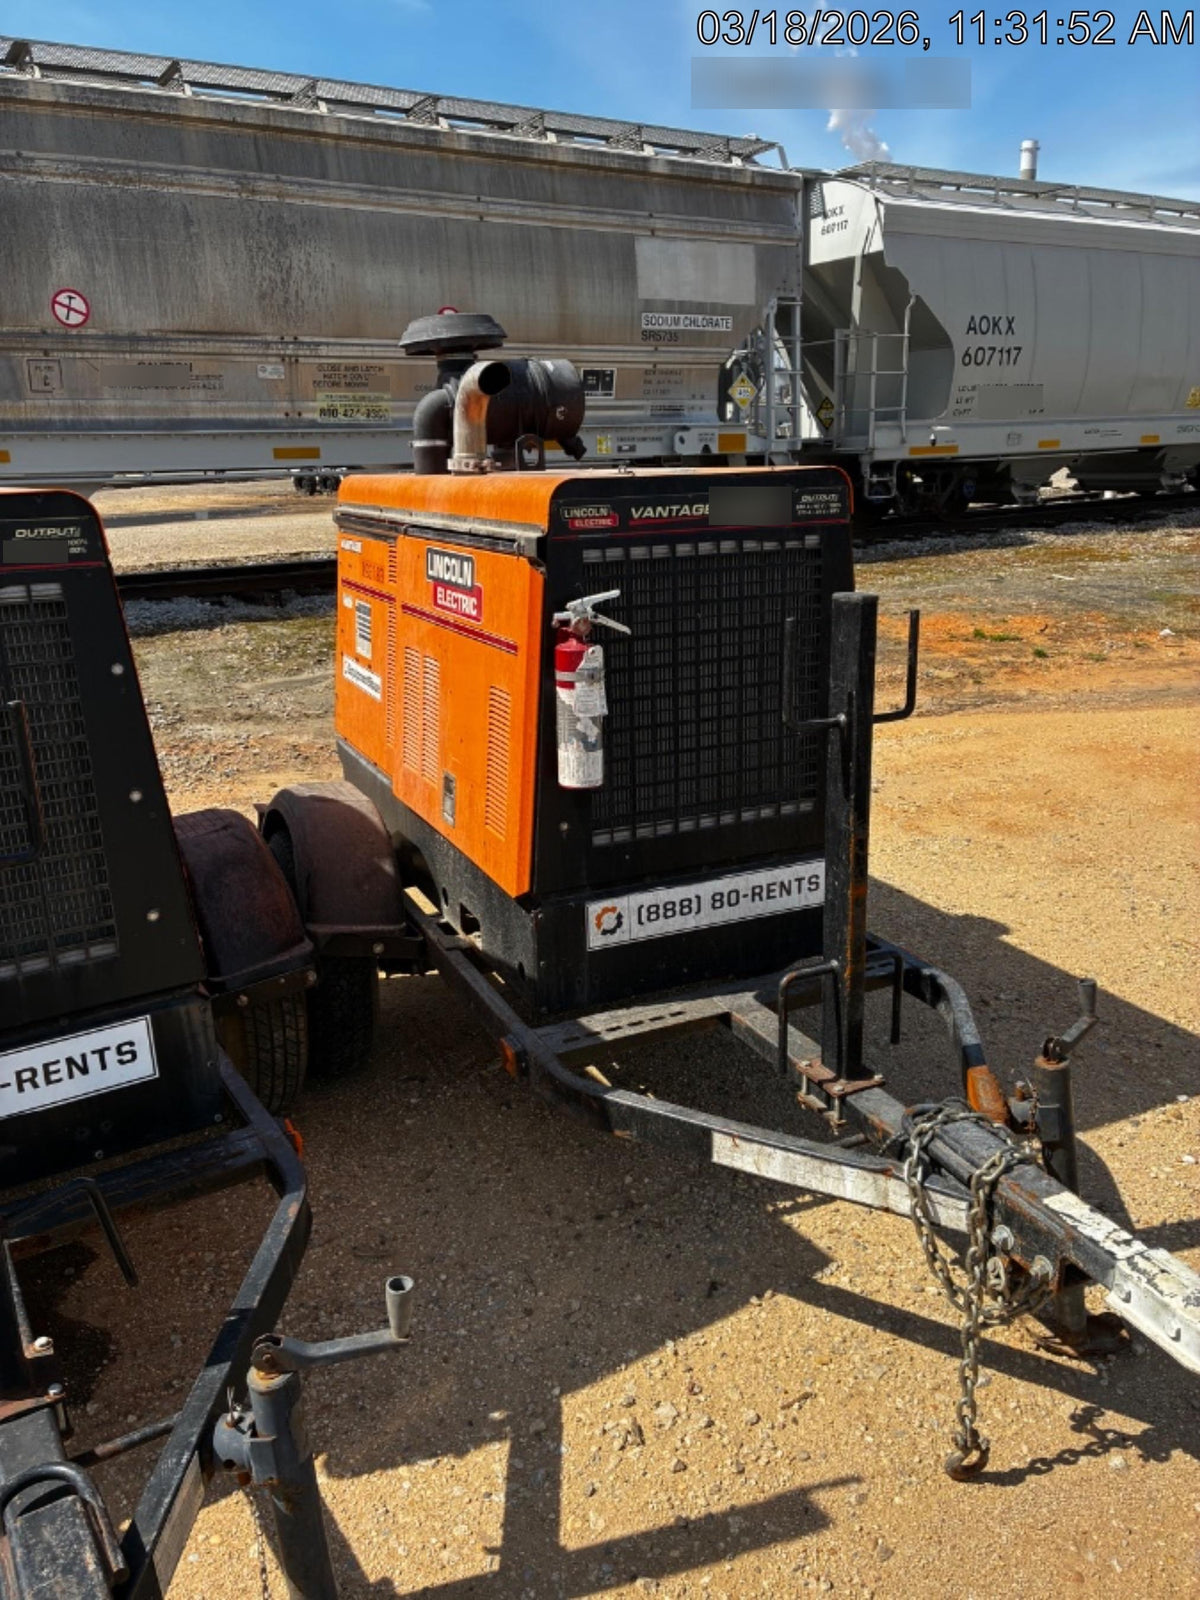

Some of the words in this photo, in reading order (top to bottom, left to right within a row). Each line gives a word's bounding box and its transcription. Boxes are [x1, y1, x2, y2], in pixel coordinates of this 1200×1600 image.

[643, 314, 680, 326] SODIUM
[682, 316, 730, 329] CHLORATE
[966, 314, 1015, 335] AOKX
[961, 346, 1022, 367] 607117
[564, 507, 608, 518] LINCOLN
[575, 518, 613, 528] ELECTRIC
[15, 527, 77, 538] OUTPUT
[427, 552, 472, 588] LINCOLN
[437, 586, 478, 616] ELECTRIC
[637, 894, 701, 926] (888)
[711, 874, 821, 910] 80-RENTS
